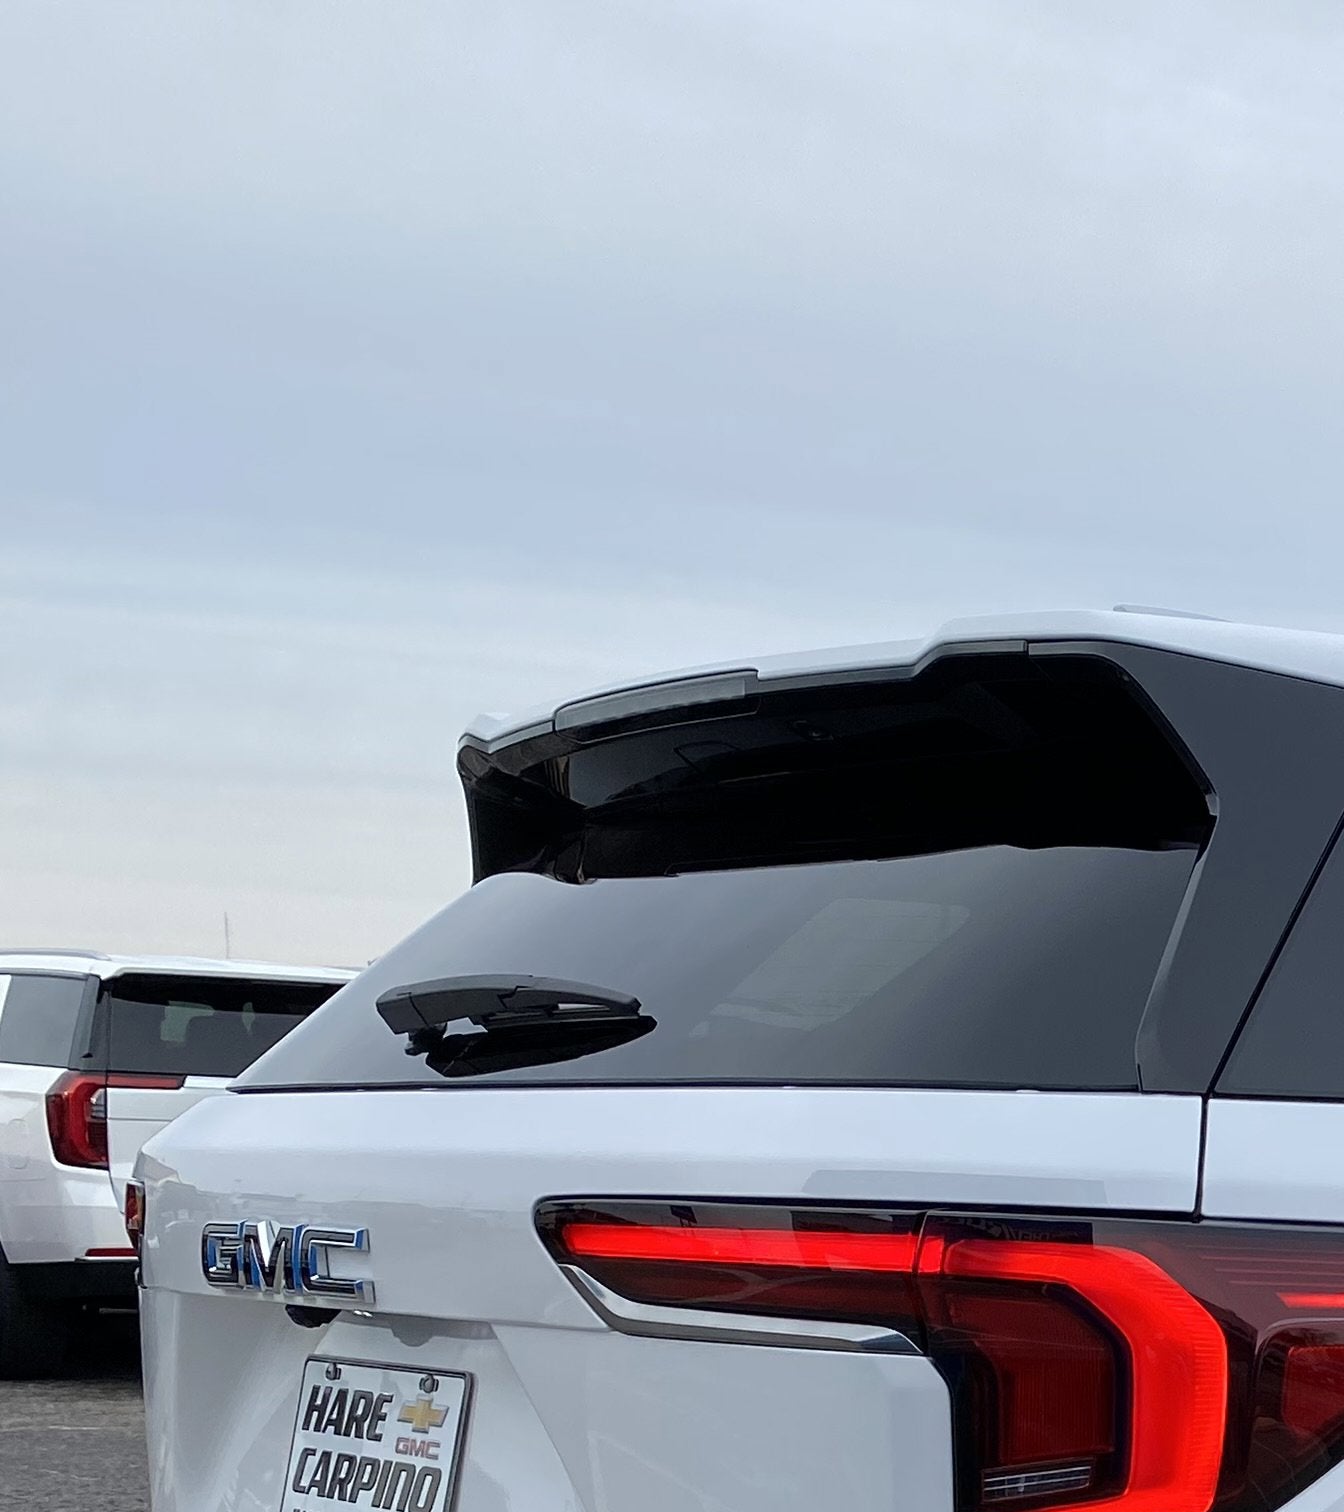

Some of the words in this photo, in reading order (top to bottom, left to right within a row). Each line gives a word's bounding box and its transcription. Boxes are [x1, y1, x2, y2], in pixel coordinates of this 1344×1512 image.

[201, 1217, 377, 1305] GMC
[302, 1384, 394, 1442] HARE
[395, 1437, 441, 1460] GMC
